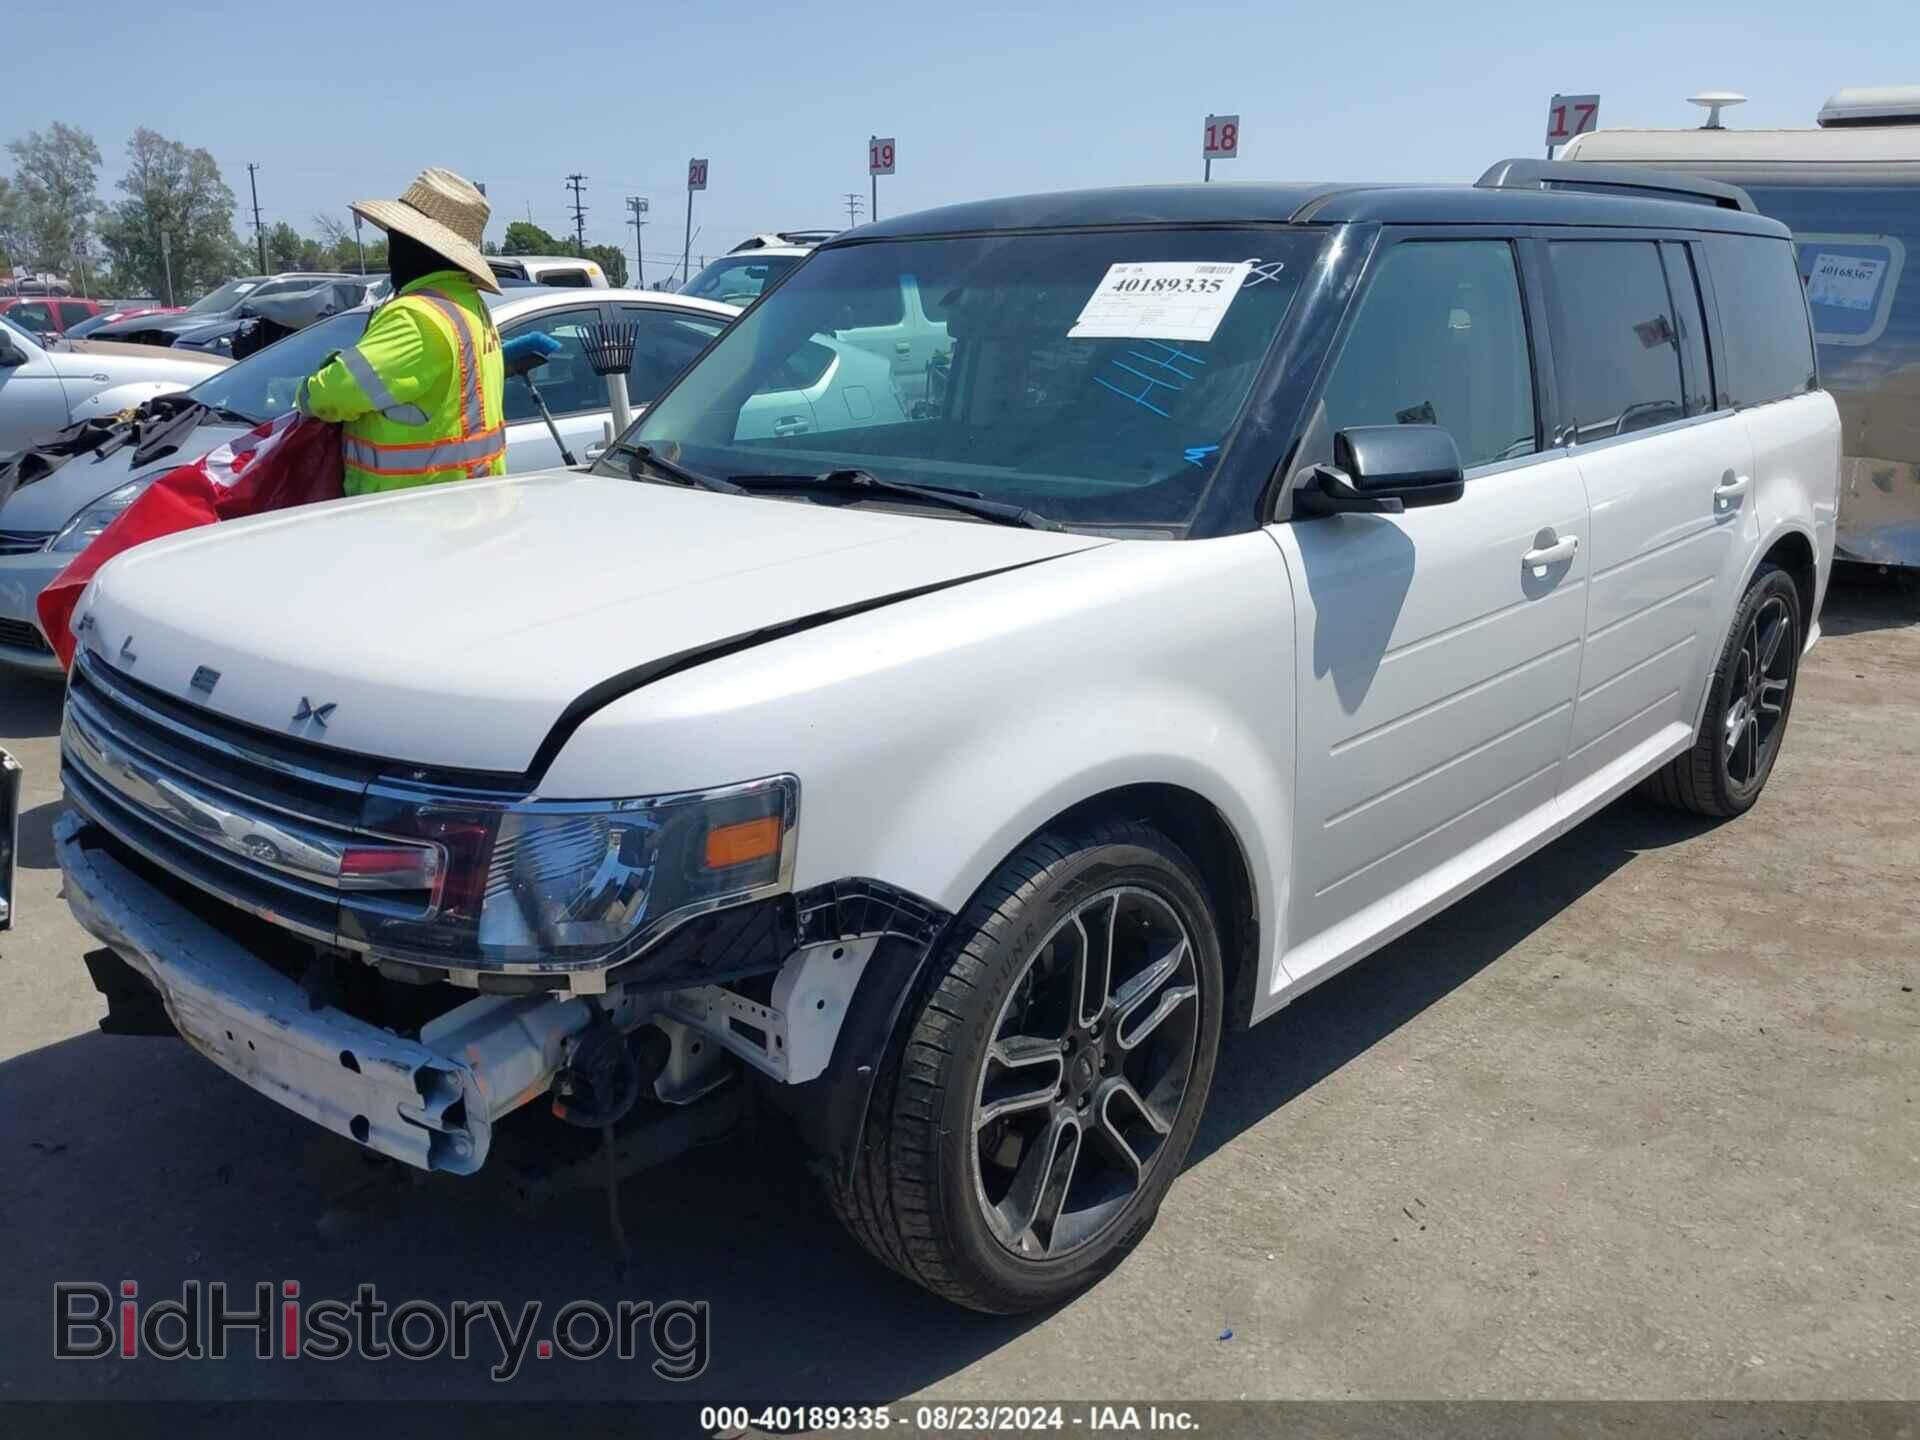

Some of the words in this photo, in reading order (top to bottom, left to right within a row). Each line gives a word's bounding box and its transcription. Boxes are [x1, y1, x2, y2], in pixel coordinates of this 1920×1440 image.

[1550, 104, 1596, 137] 17
[1204, 124, 1236, 151] 18
[870, 145, 894, 169] 19
[689, 164, 707, 185] 20
[1820, 264, 1873, 279] 40168367
[1112, 278, 1224, 293] 40189335
